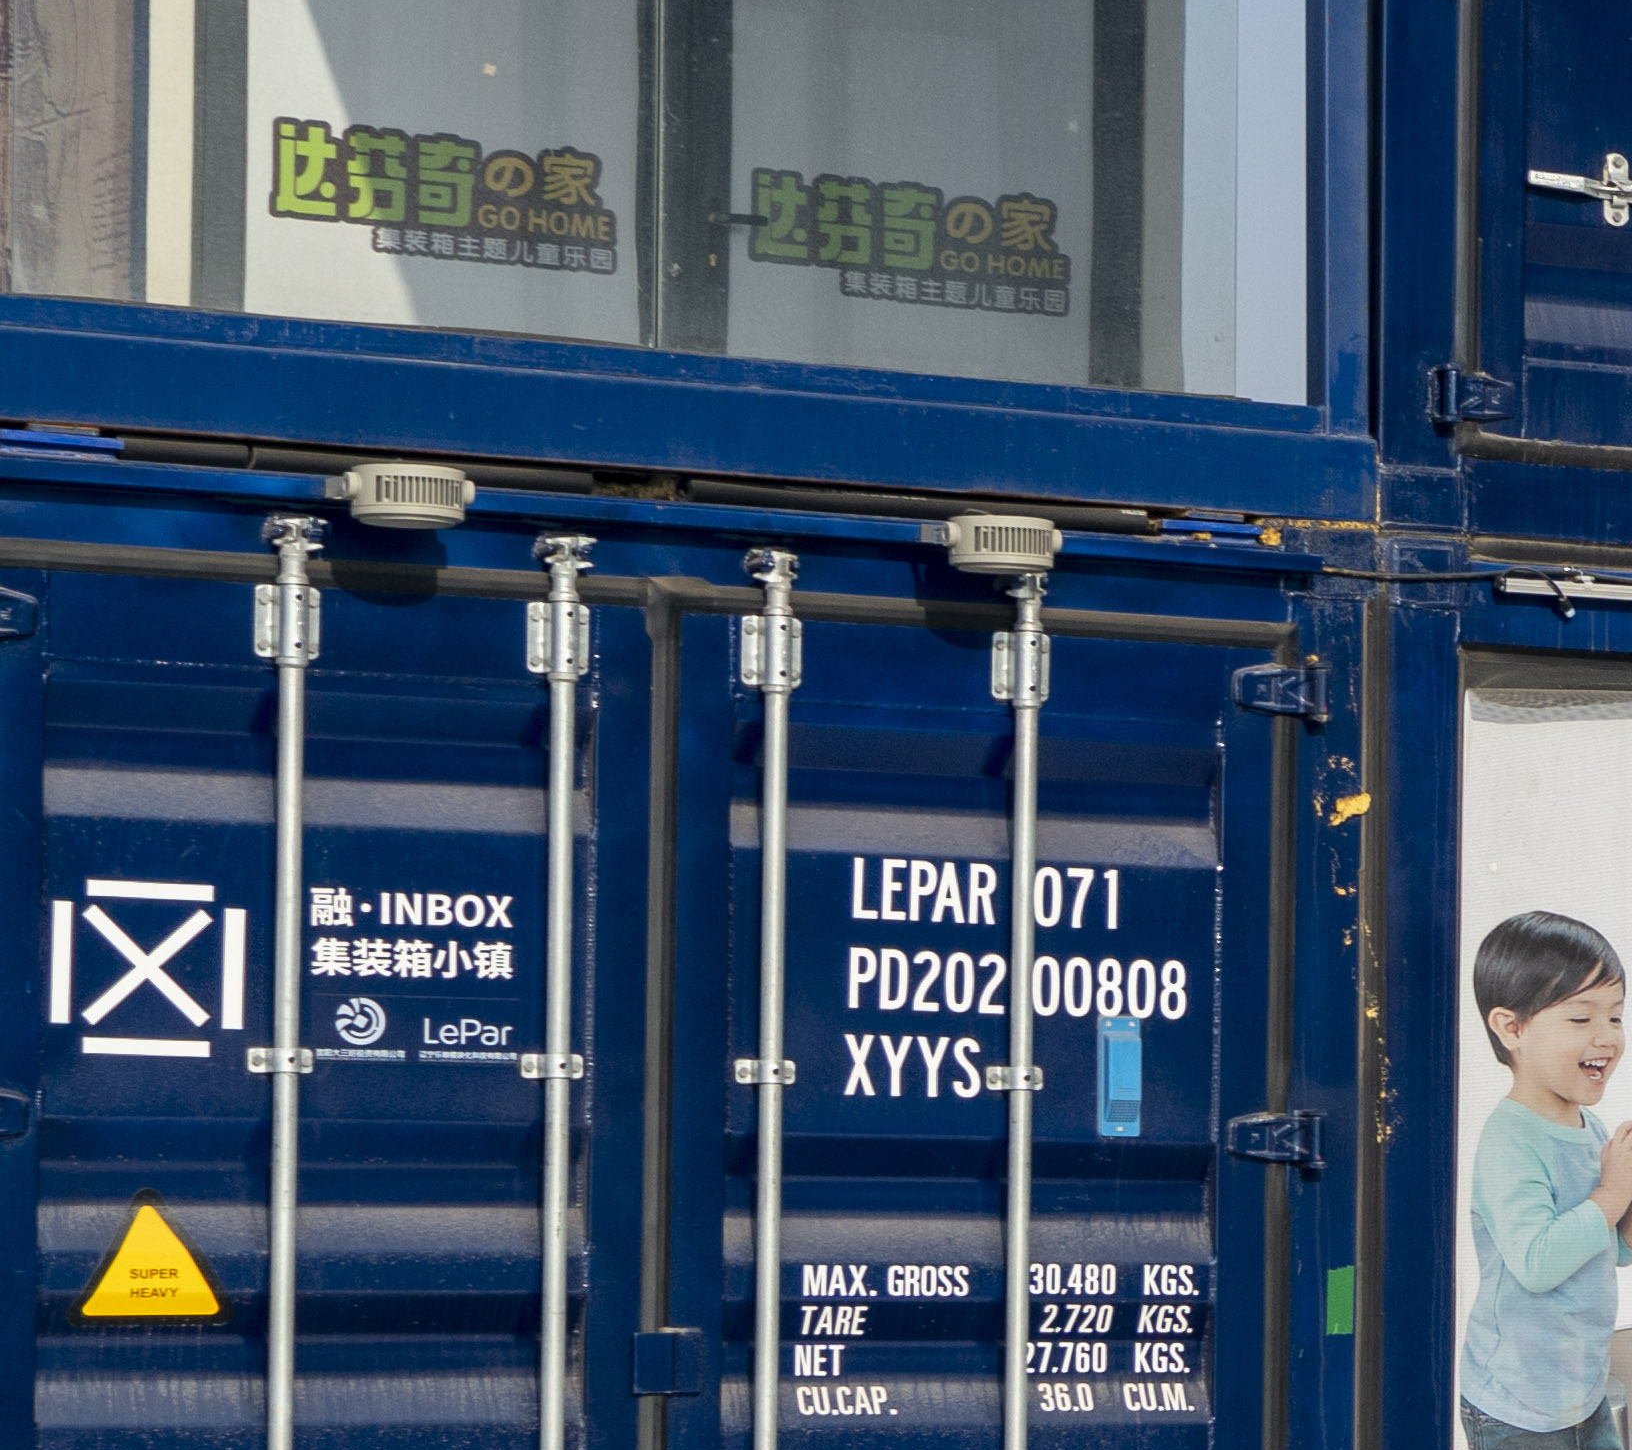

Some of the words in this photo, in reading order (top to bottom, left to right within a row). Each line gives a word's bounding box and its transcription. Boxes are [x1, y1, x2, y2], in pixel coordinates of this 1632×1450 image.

[278, 122, 601, 226] 达芬奇の家
[478, 203, 521, 230] GO
[526, 207, 611, 242] HOME
[756, 171, 1057, 269] 达芬奇の家
[375, 226, 614, 272] 集装箱主题儿童乐园
[940, 249, 981, 273] GO
[989, 253, 1066, 281] HOME
[843, 271, 1068, 314] 集装箱主题儿童乐园
[853, 857, 996, 924] LEPAR
[310, 938, 514, 980] 集装箱小镇
[423, 1018, 514, 1046] LePar
[844, 1034, 980, 1097] XYYS
[129, 1268, 179, 1280] SUPER
[803, 1265, 877, 1296] MAX.
[888, 1266, 968, 1296] GROSS
[1029, 1264, 1116, 1294] 30.480
[1144, 1265, 1199, 1295] KGS.
[129, 1286, 179, 1299] HEAVY
[802, 1306, 868, 1335] TARE
[1040, 1304, 1113, 1333] 2.720
[1138, 1305, 1192, 1333] KGS.
[795, 1345, 844, 1376] NET
[1025, 1343, 1108, 1374] 27.760
[1135, 1343, 1189, 1373] KGS.
[1038, 1383, 1093, 1411] 36.0
[1123, 1383, 1194, 1411] CU.M.
